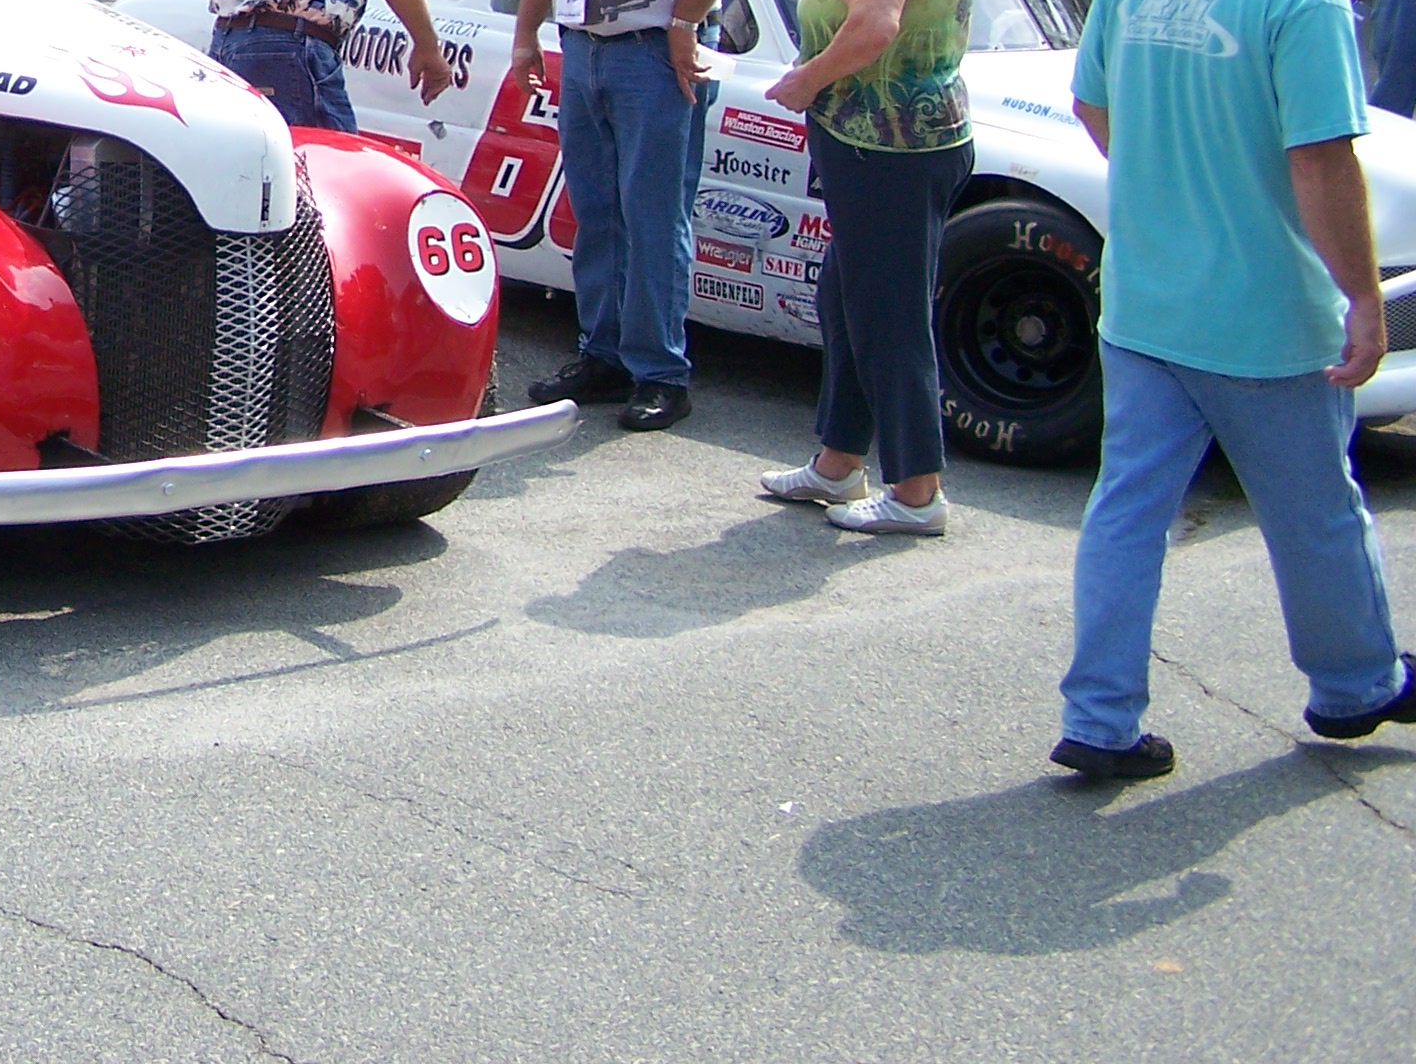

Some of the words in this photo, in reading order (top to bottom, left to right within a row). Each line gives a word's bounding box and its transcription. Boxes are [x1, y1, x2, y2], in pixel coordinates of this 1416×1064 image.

[1001, 96, 1052, 118] HUDSON
[724, 116, 765, 135] Winston
[764, 125, 804, 147] Racing
[709, 148, 791, 185] Hoosier
[797, 213, 832, 242] MS
[417, 222, 485, 276] 66
[697, 240, 752, 268] Wrangler
[795, 236, 825, 253] IGNI
[765, 257, 803, 277] SAFE
[697, 277, 761, 306] SCHOENFELD
